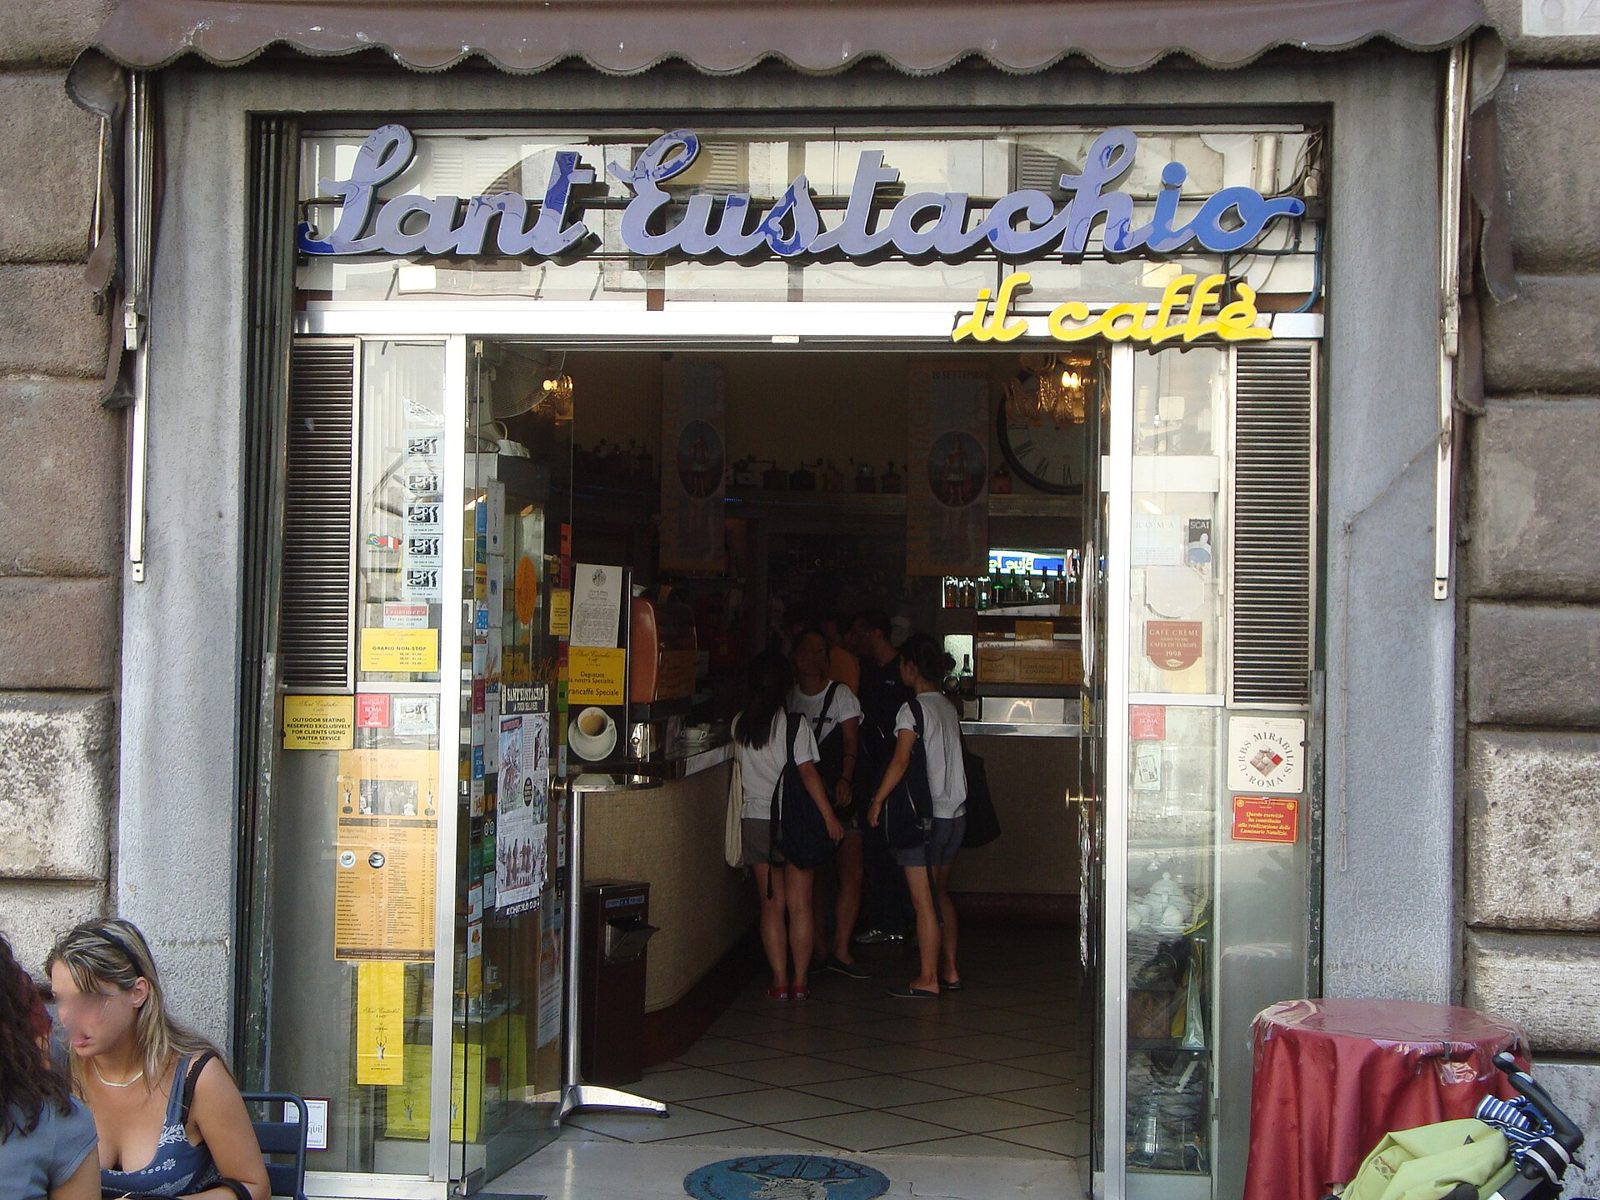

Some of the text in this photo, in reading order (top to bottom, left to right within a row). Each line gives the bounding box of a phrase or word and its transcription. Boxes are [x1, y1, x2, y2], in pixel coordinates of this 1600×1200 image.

[608, 127, 1306, 257] Eustachio
[952, 272, 1273, 345] il caffè
[1238, 731, 1295, 774] URBS MIRABILIS
[1248, 774, 1285, 788] ROMA
